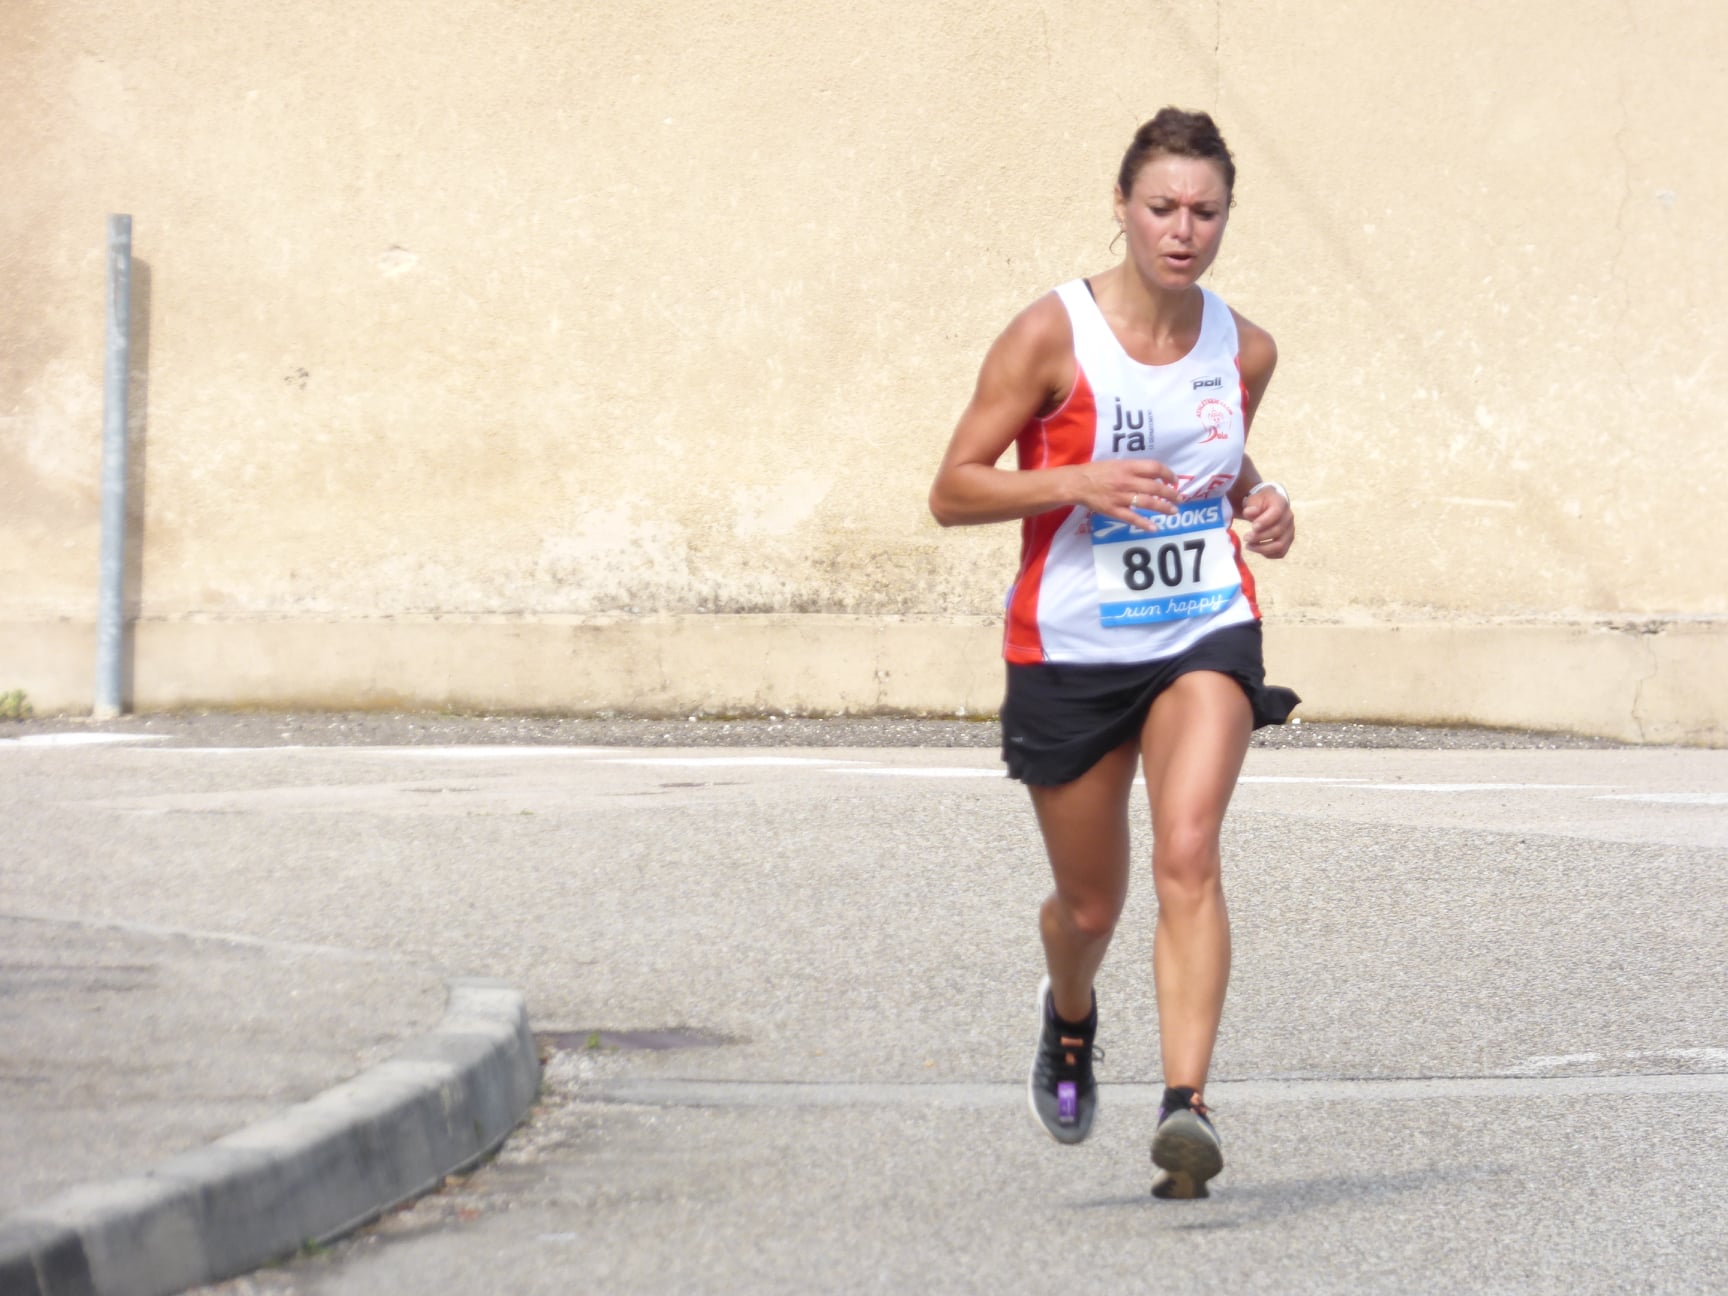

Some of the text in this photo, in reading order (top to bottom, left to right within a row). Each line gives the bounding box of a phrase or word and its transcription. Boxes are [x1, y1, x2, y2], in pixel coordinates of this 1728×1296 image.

[1112, 397, 1145, 431] ju
[1112, 431, 1147, 453] ra
[1122, 537, 1206, 591] 807
[1117, 593, 1225, 619] run happy
